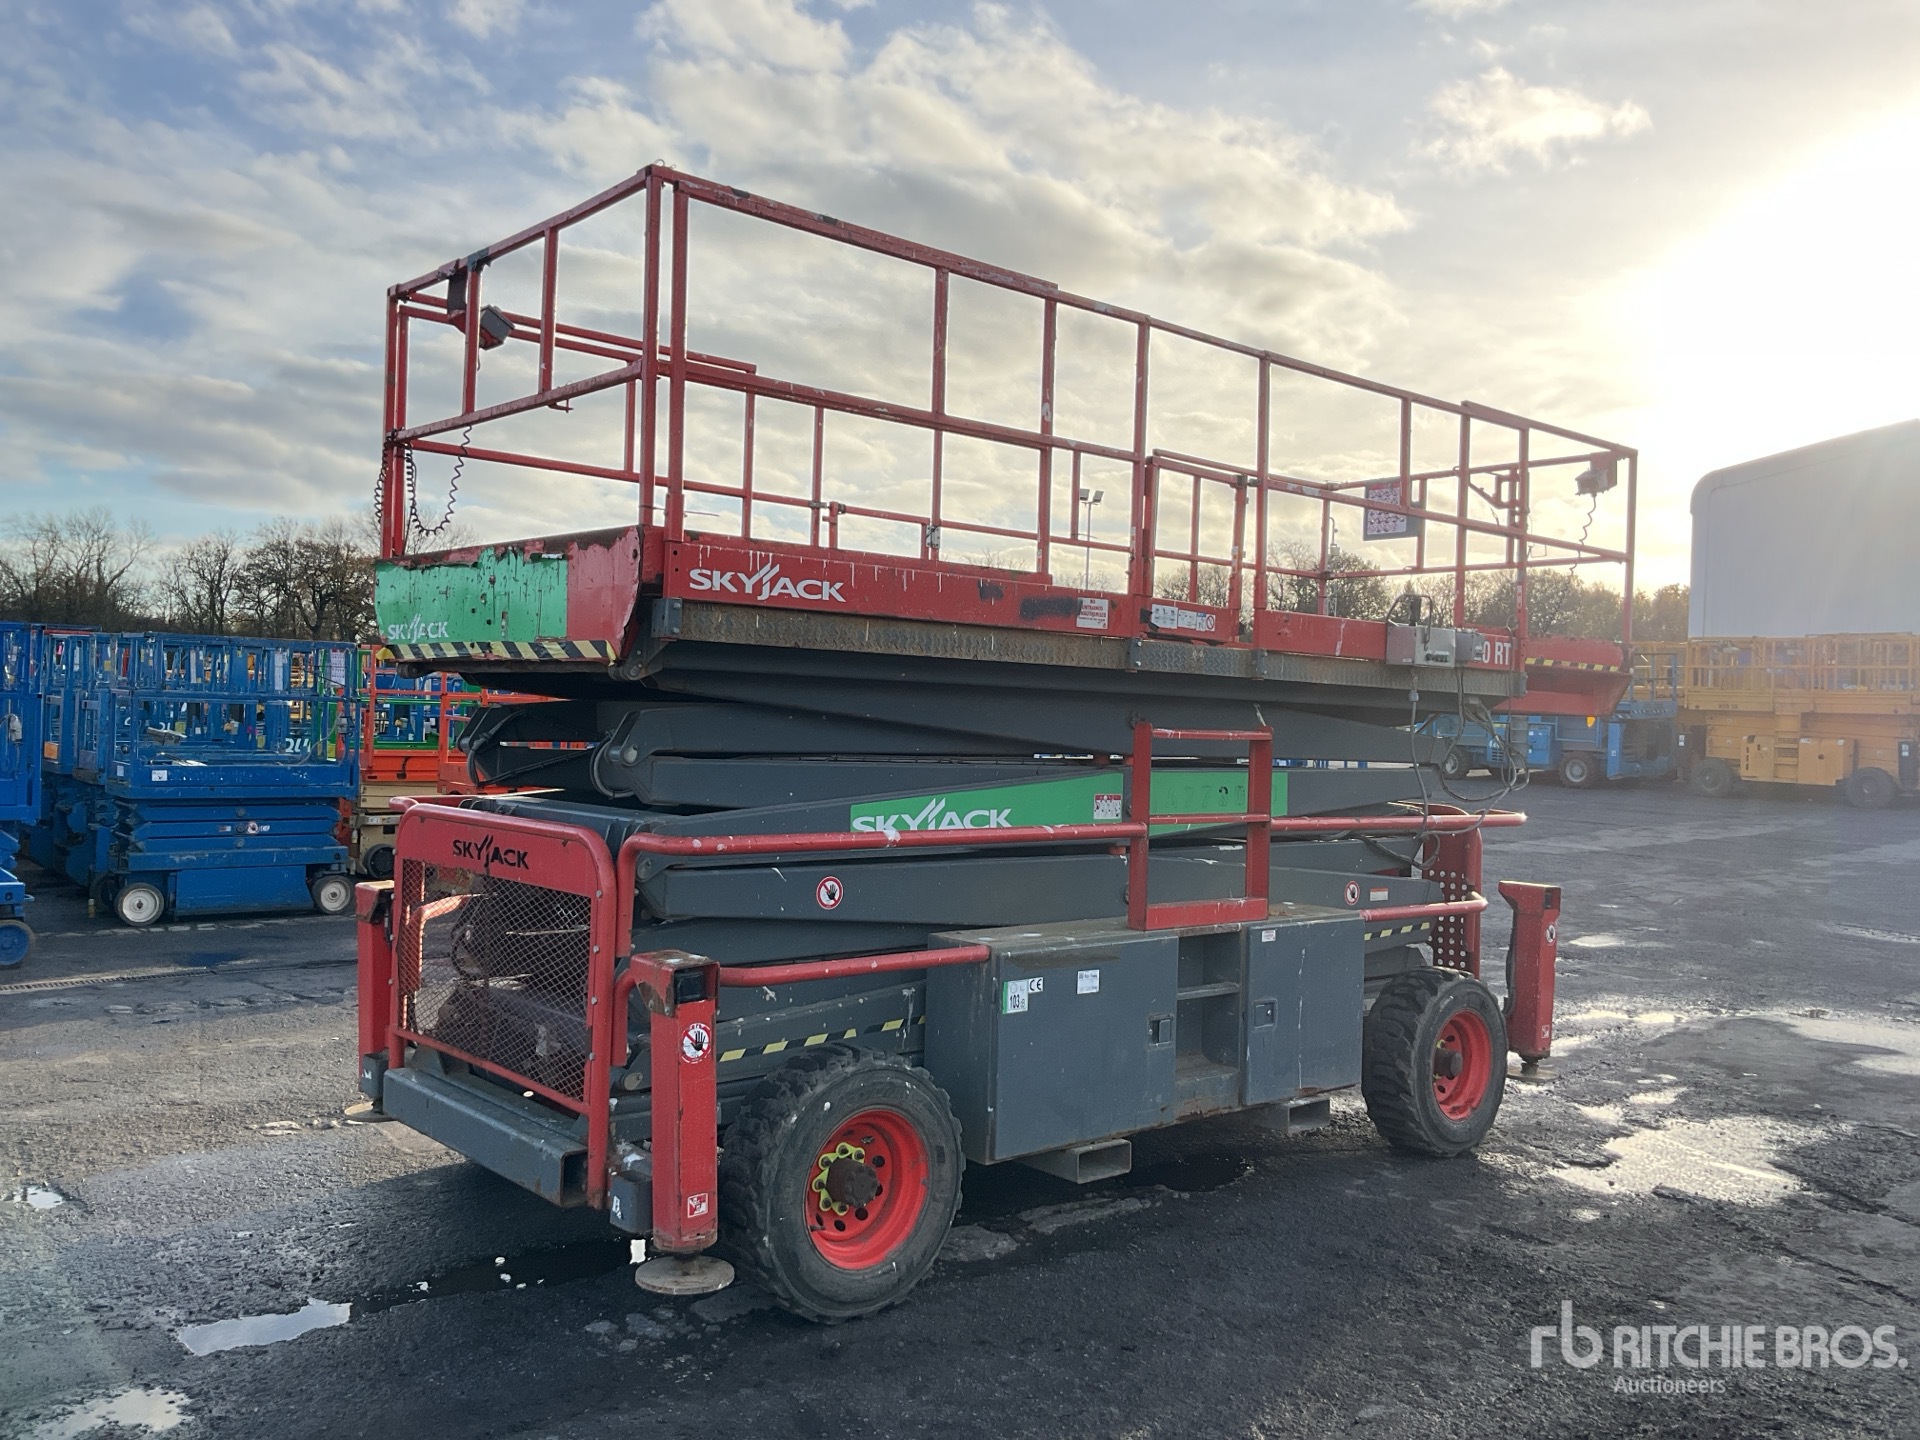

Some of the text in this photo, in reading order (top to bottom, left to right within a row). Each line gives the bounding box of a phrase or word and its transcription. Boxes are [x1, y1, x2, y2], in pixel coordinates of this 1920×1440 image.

[690, 563, 846, 603] SKYJACK
[388, 613, 449, 643] SKYJACK
[1494, 641, 1512, 665] RT
[852, 797, 1012, 832] SKYJACK
[453, 834, 529, 870] SKYJACK
[1009, 994, 1020, 1009] 103
